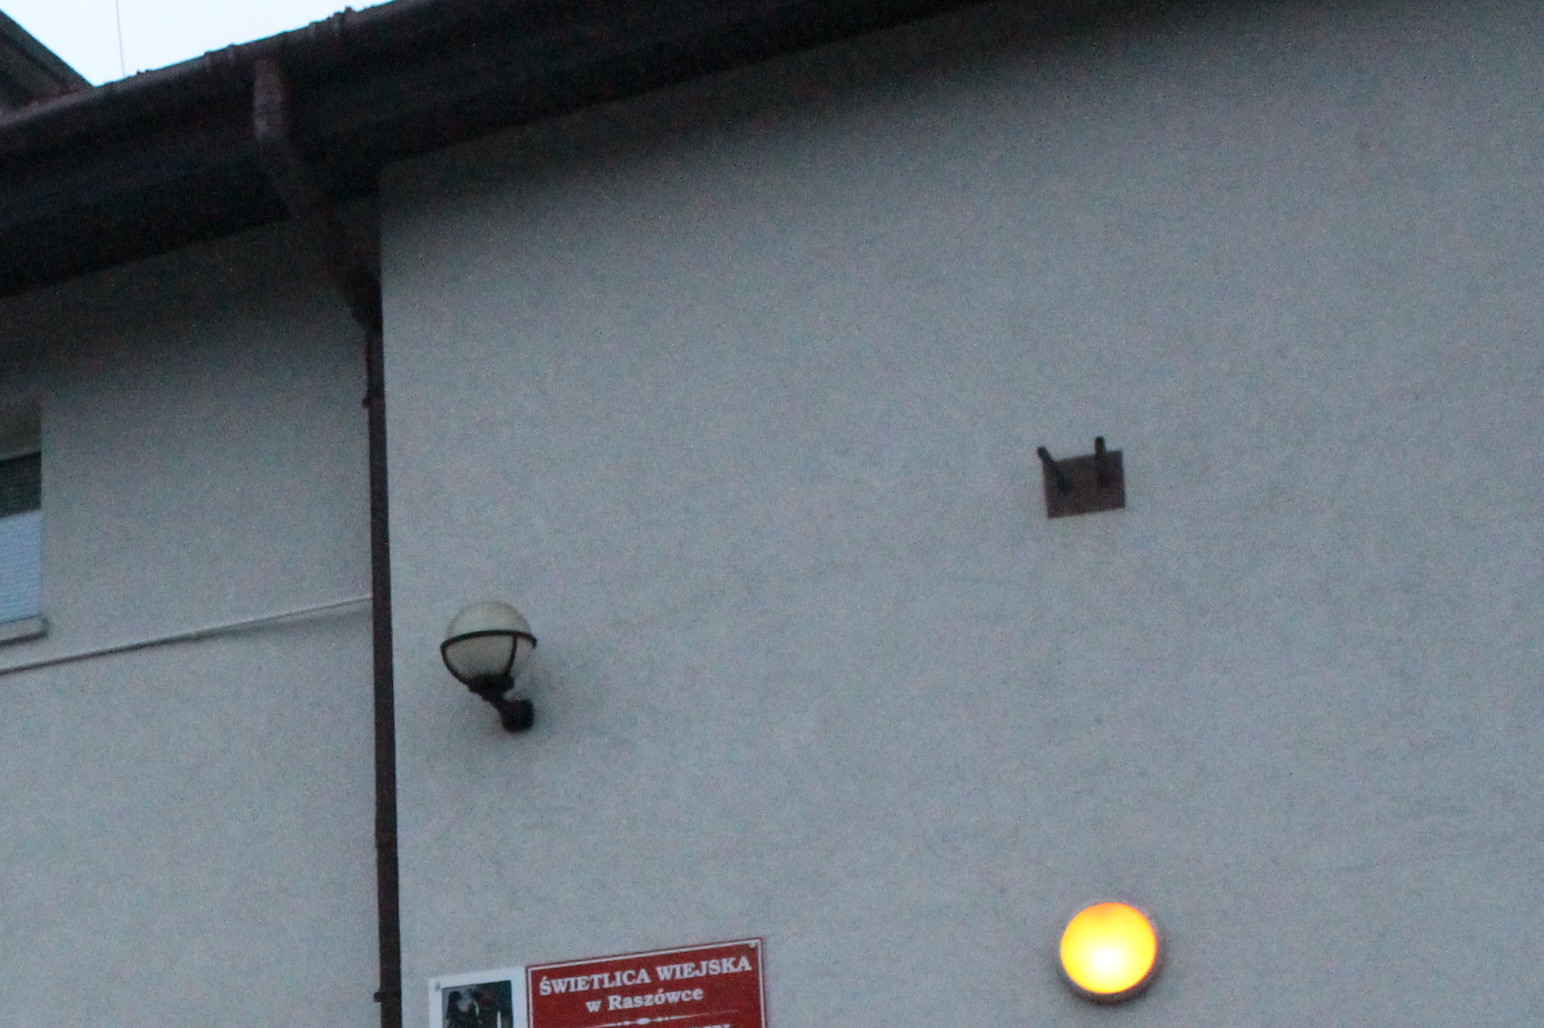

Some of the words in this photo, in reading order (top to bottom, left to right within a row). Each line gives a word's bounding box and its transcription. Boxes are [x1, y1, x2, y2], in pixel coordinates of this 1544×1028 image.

[538, 968, 651, 996] ŚWIETLICA
[656, 956, 752, 981] WIEJSKA
[585, 1000, 602, 1013] w
[608, 987, 704, 1011] Raszówce
